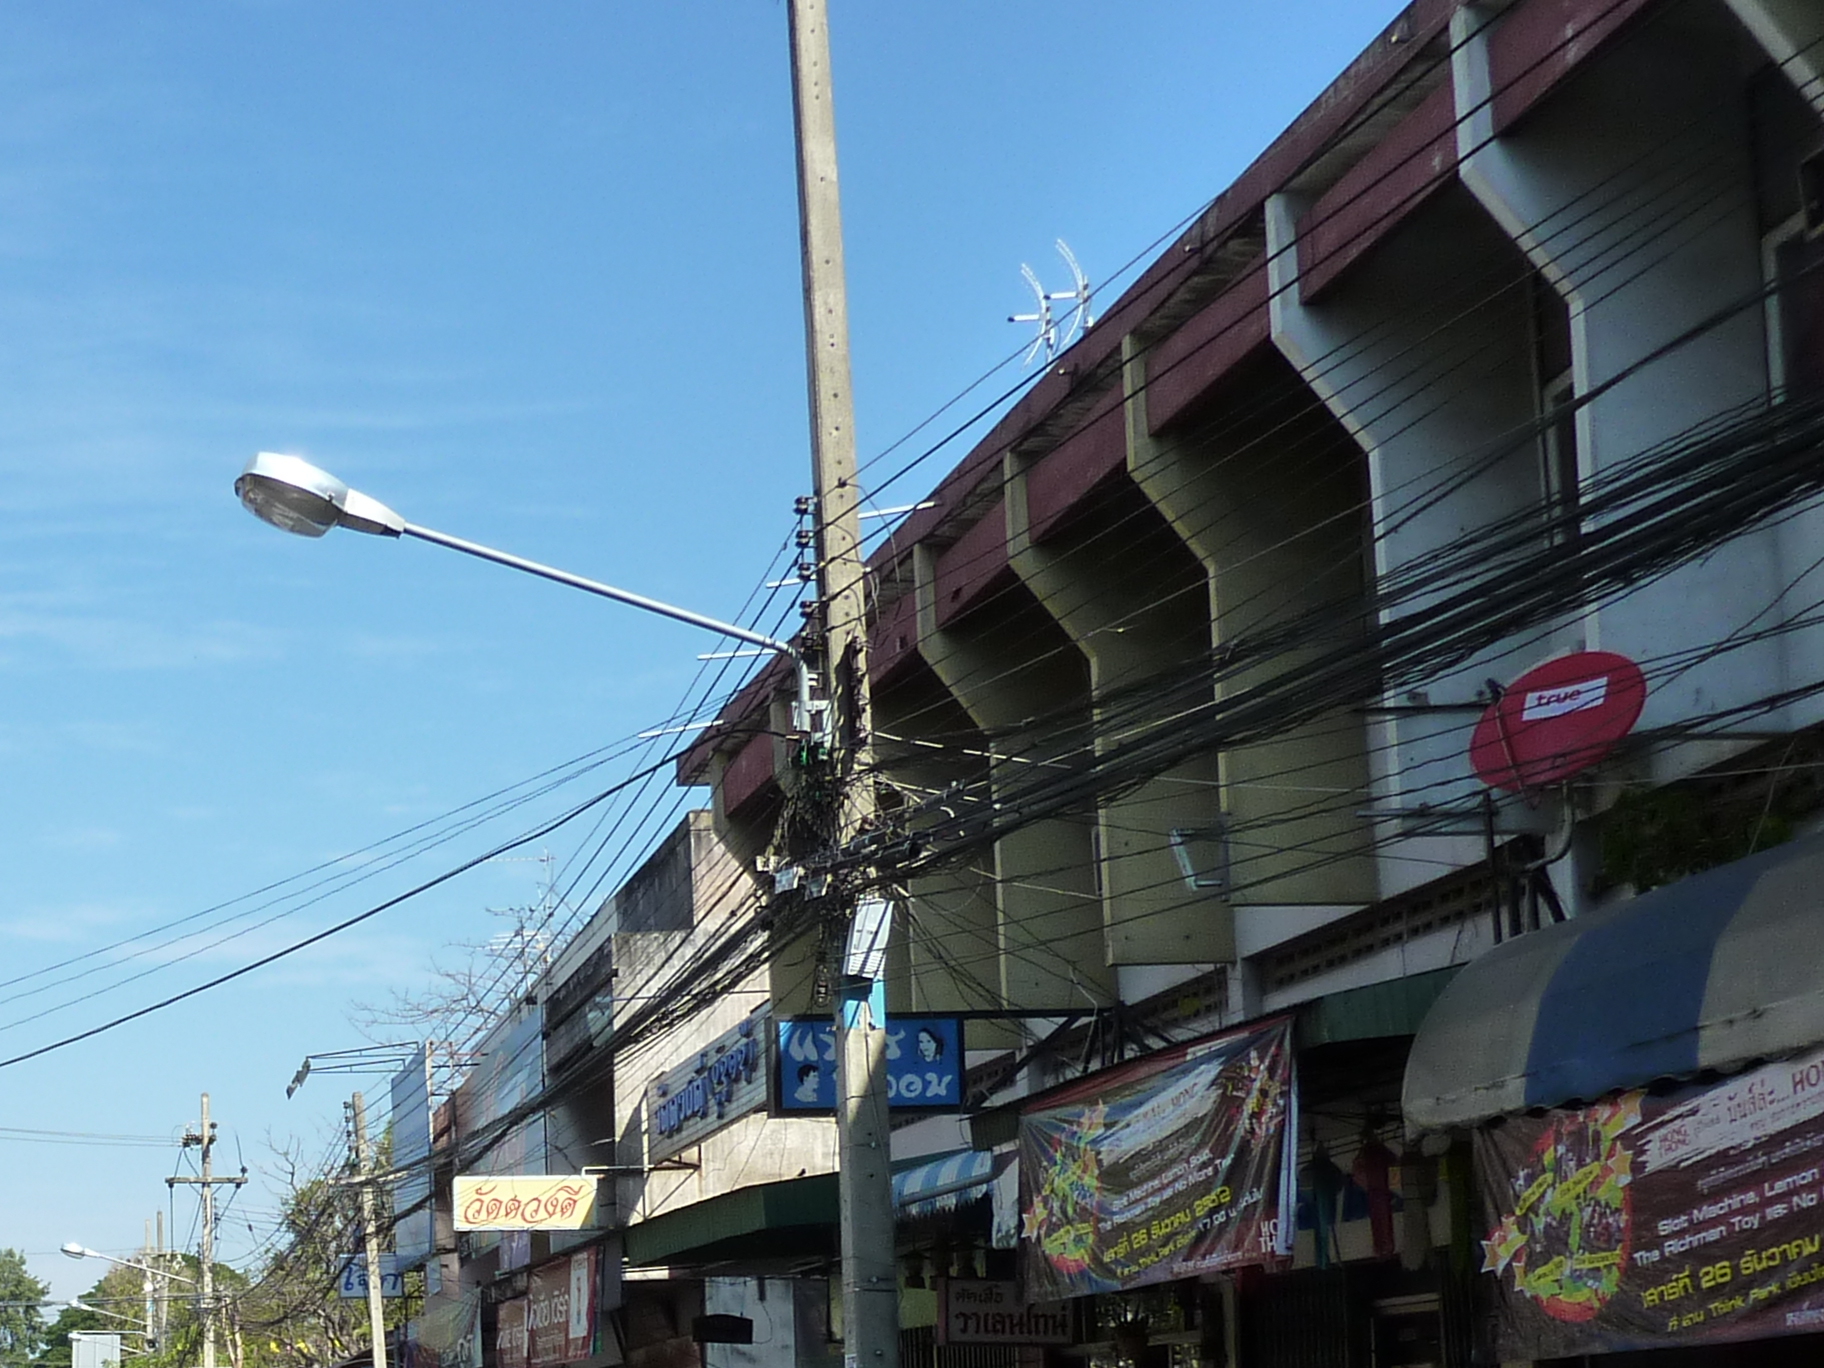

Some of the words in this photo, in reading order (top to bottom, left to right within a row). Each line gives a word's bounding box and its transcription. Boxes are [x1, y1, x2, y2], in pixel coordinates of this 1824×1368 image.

[1537, 689, 1581, 706] true
[1791, 1060, 1824, 1095] HO
[1658, 1214, 1689, 1236] Slot
[1763, 1168, 1819, 1197] Lemon
[1131, 1229, 1149, 1249] 26
[1633, 1248, 1660, 1267] The
[1664, 1225, 1727, 1257] Richman
[1730, 1213, 1761, 1232] Toy
[1792, 1192, 1818, 1212] No
[1641, 1264, 1695, 1308] เสาร์ที่
[1699, 1259, 1733, 1290] 26
[1739, 1234, 1821, 1276] ธันวาคม
[1708, 1296, 1745, 1318] Think
[1749, 1280, 1782, 1305] Park
